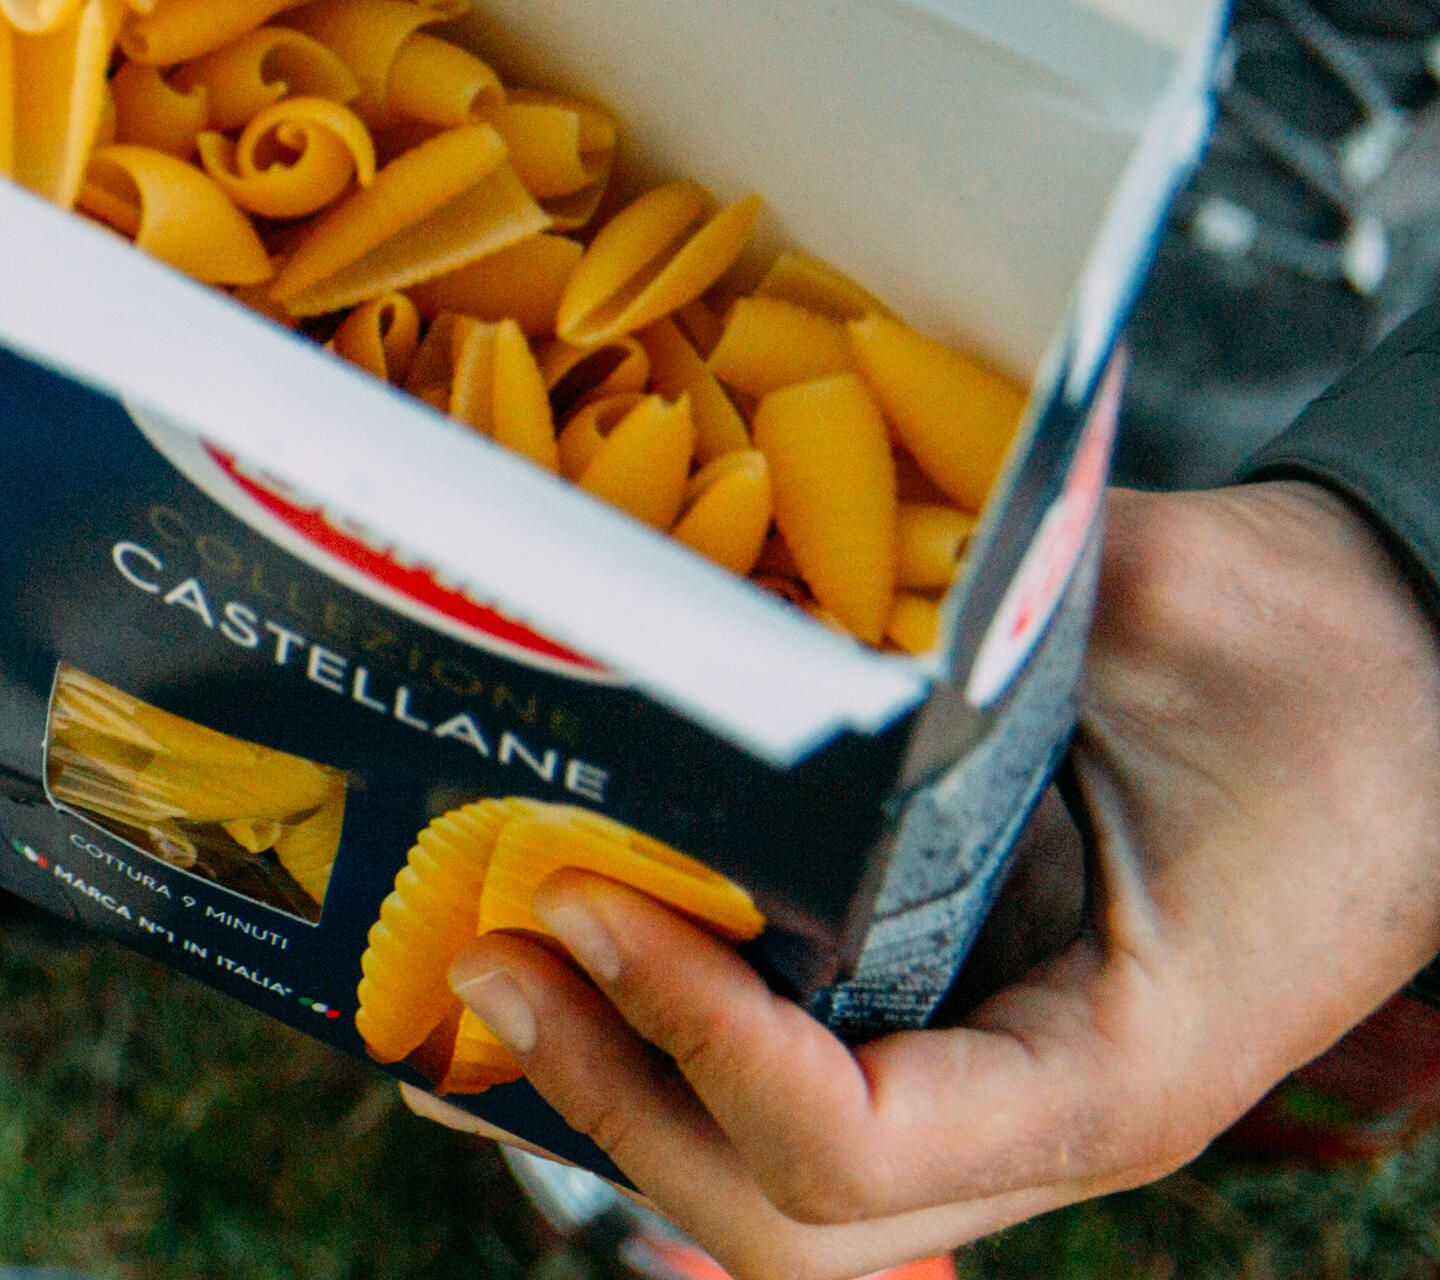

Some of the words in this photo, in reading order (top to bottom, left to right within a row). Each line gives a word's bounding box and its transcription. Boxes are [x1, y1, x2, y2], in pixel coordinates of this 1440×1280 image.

[112, 540, 609, 803] CASTELLANE
[148, 505, 582, 744] COLLEZIONE
[53, 864, 132, 920] MARCA
[183, 939, 208, 959] IN
[70, 833, 171, 898] COTTURA
[182, 895, 196, 908] 9
[205, 905, 288, 950] MINUTI
